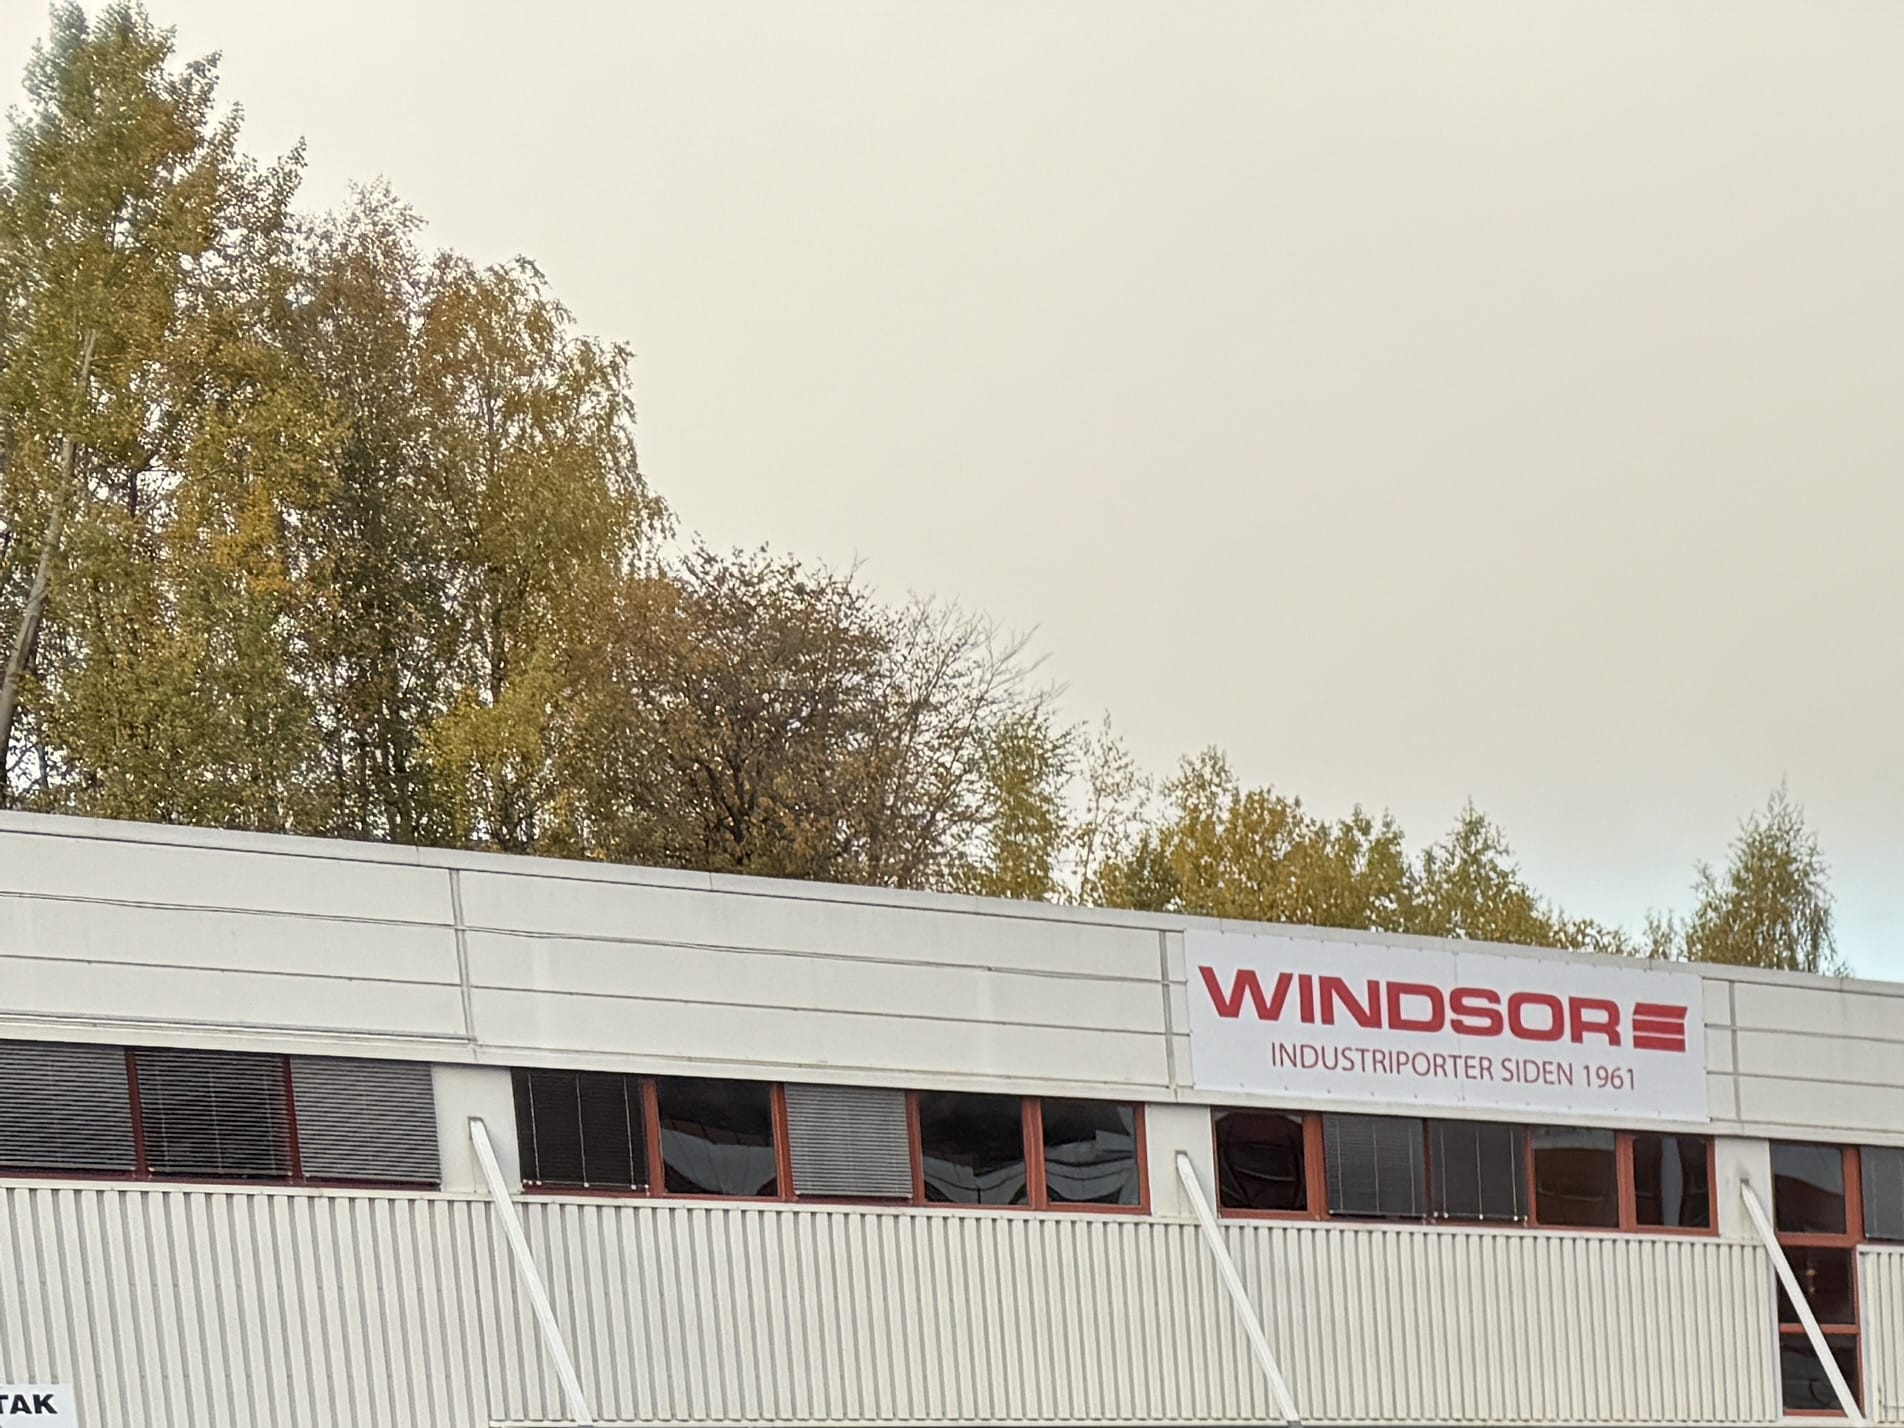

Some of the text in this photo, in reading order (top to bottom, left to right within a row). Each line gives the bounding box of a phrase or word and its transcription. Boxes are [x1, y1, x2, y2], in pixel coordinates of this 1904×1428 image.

[1198, 965, 1621, 1047] WINDSOR
[1271, 1042, 1636, 1090] INDUSTRIPORTER SIDEN 1961
